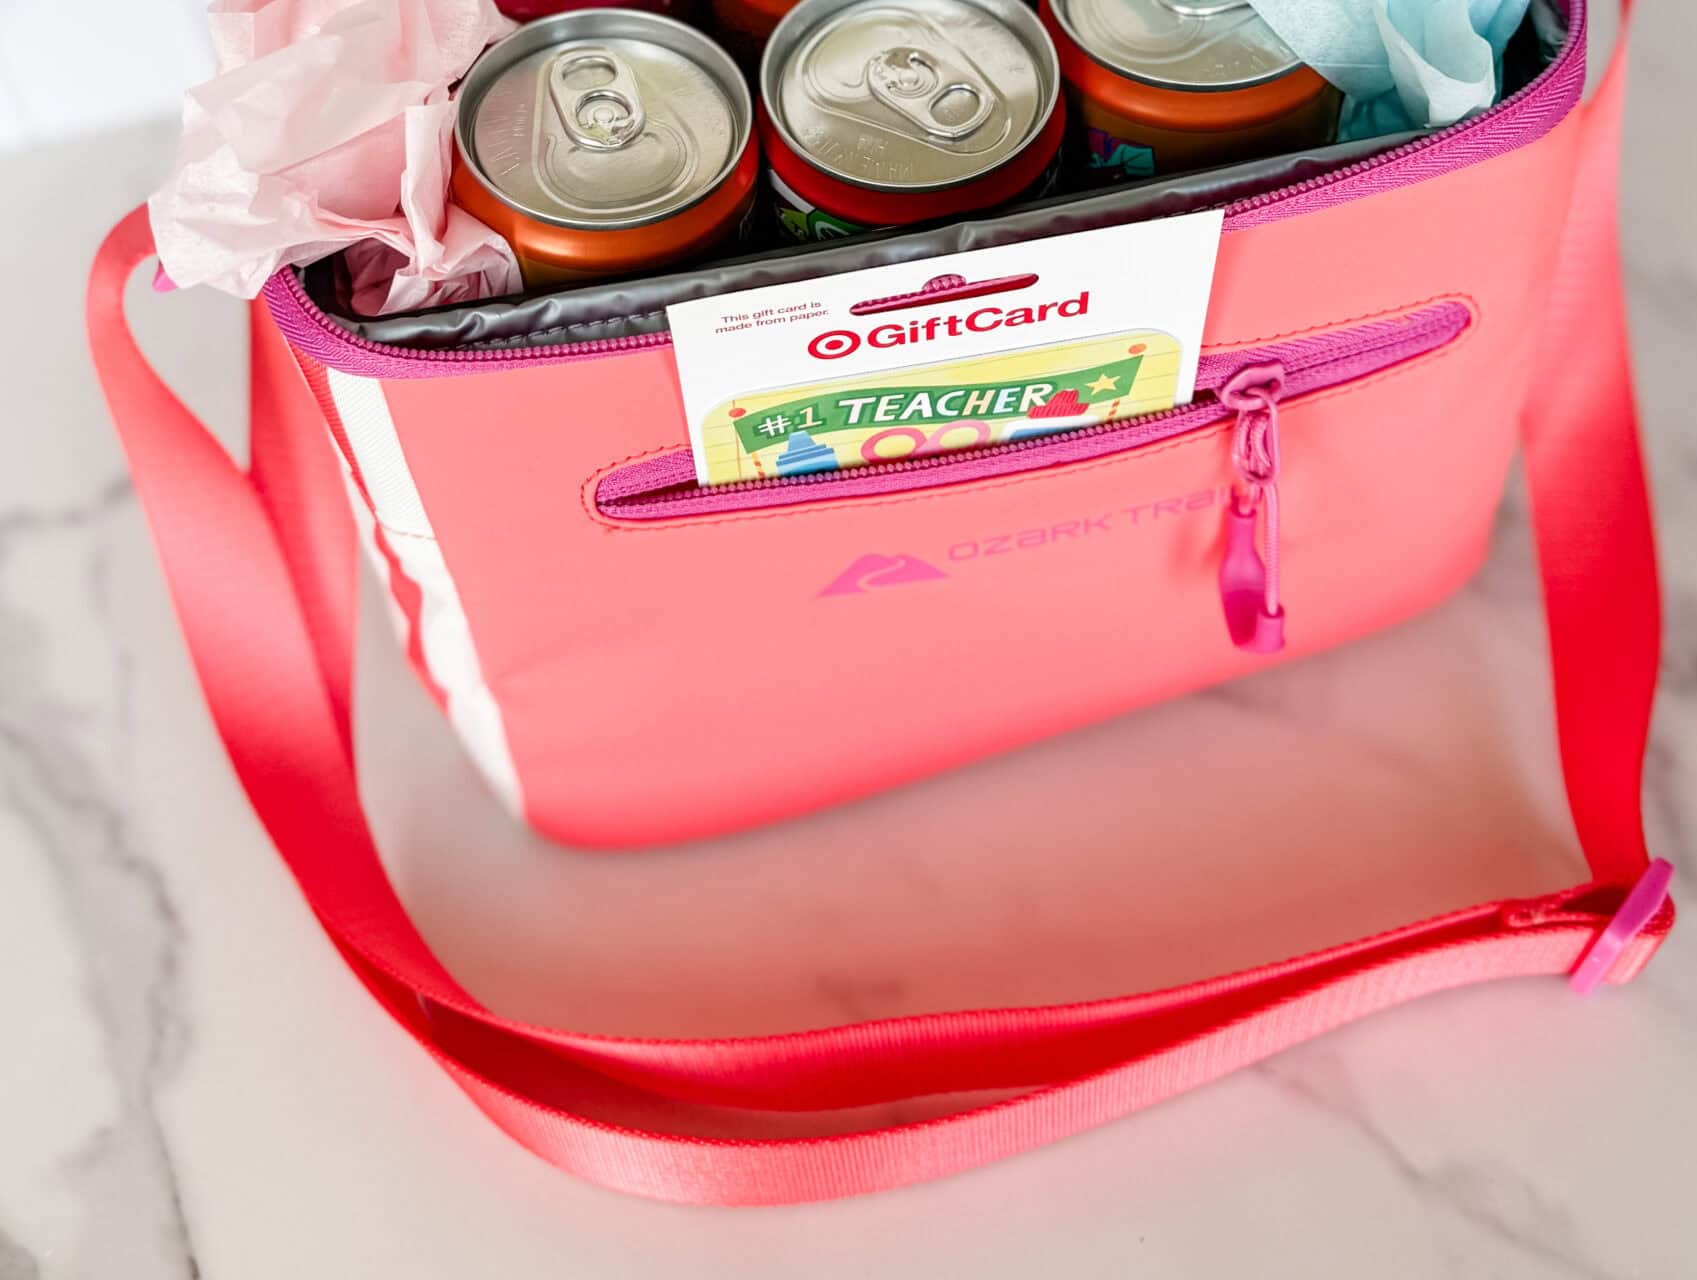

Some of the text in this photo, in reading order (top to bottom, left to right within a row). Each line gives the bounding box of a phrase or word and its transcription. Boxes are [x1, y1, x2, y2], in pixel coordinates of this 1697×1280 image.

[715, 309, 830, 334] made from paper.
[720, 300, 823, 324] This gift card is
[867, 291, 1090, 348] GiftCard
[757, 382, 1055, 438] #1 TEACHER
